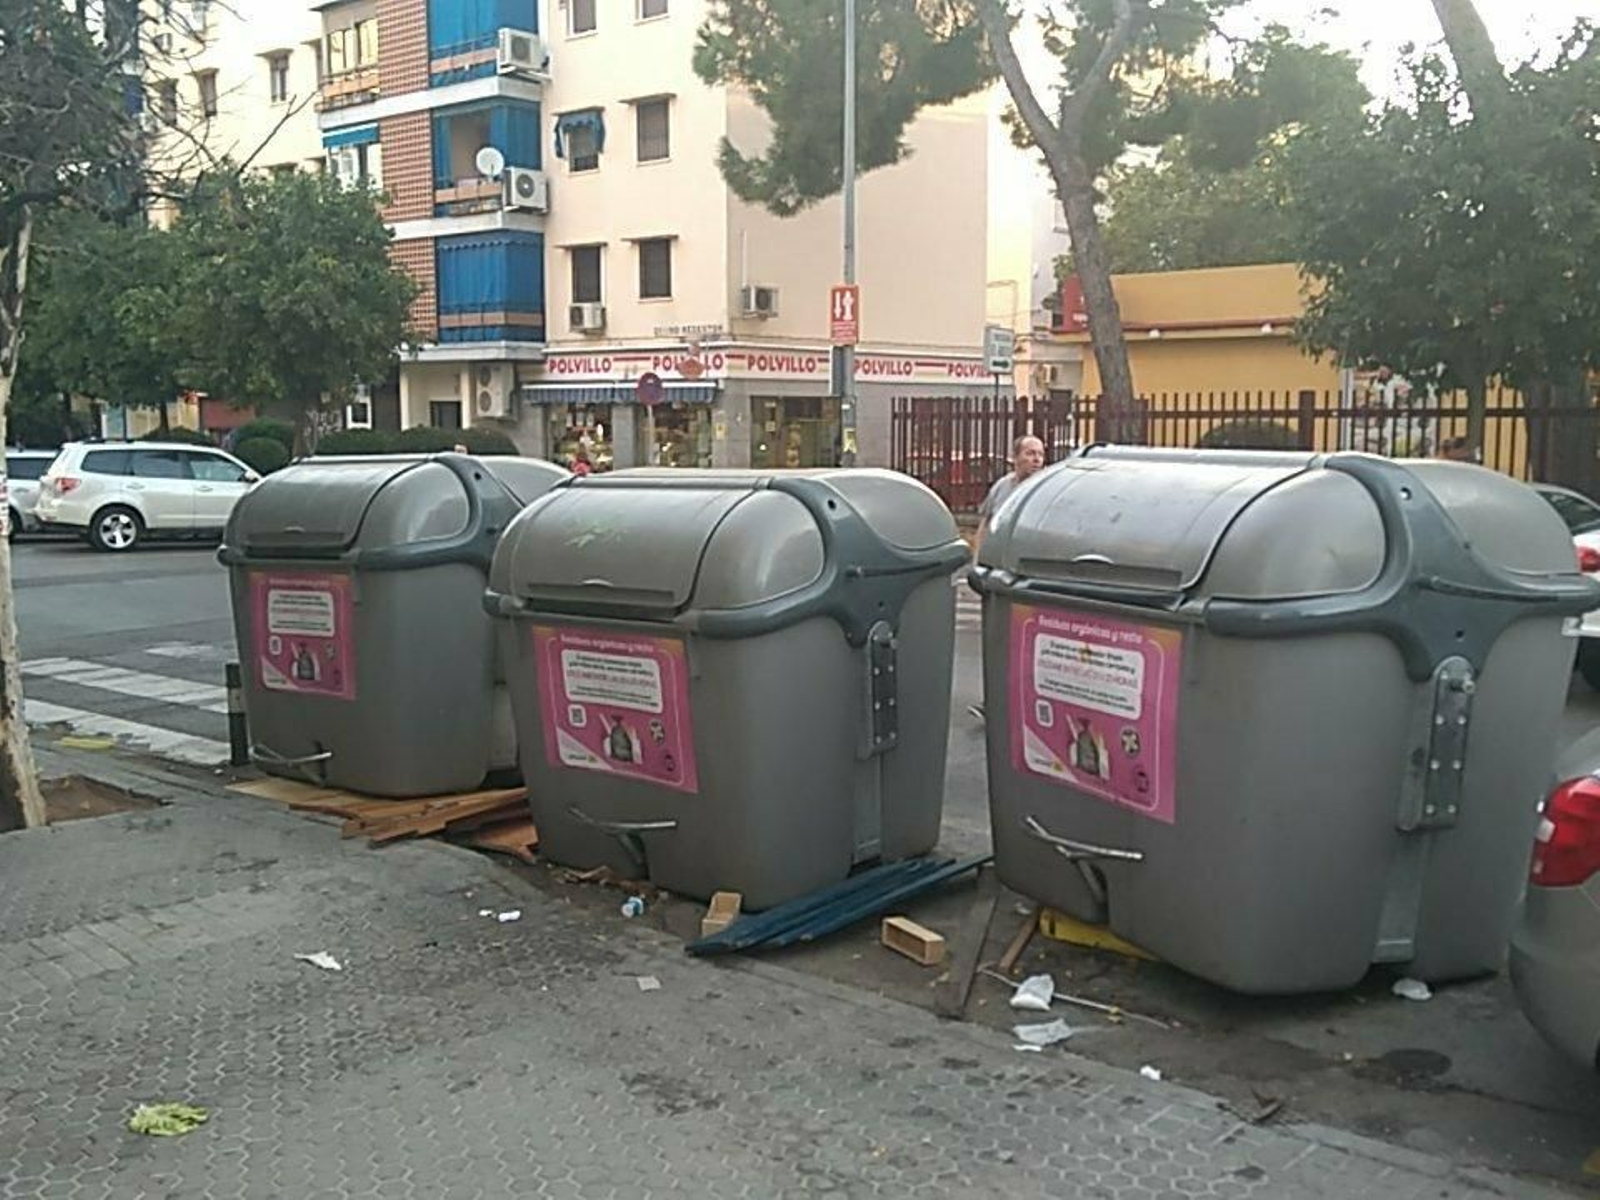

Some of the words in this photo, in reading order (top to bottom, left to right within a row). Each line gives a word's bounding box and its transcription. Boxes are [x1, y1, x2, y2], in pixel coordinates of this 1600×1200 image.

[549, 356, 612, 374] POLVILLO
[653, 354, 724, 371] POLLO
[747, 354, 816, 373] POLVILLO
[853, 359, 913, 376] POLVILLO
